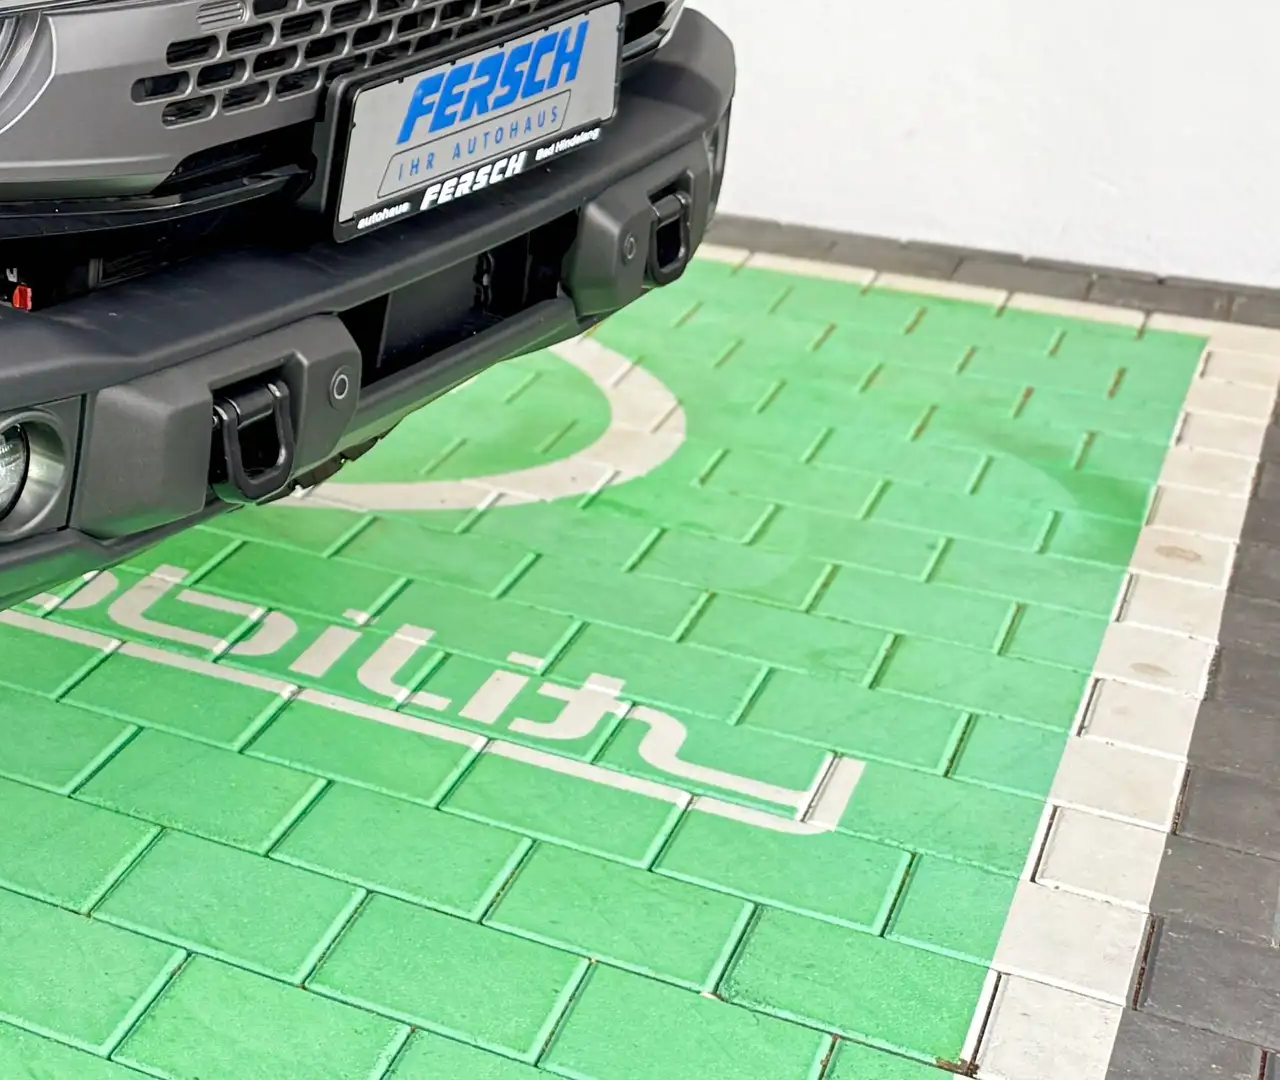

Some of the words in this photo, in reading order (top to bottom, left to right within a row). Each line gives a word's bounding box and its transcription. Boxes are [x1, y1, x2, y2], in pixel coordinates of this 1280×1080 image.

[396, 20, 590, 146] FERSCH
[398, 152, 436, 182] IHR
[452, 105, 559, 161] AUTOHAUS
[356, 201, 411, 230] autohaus
[419, 151, 529, 211] FERSCH
